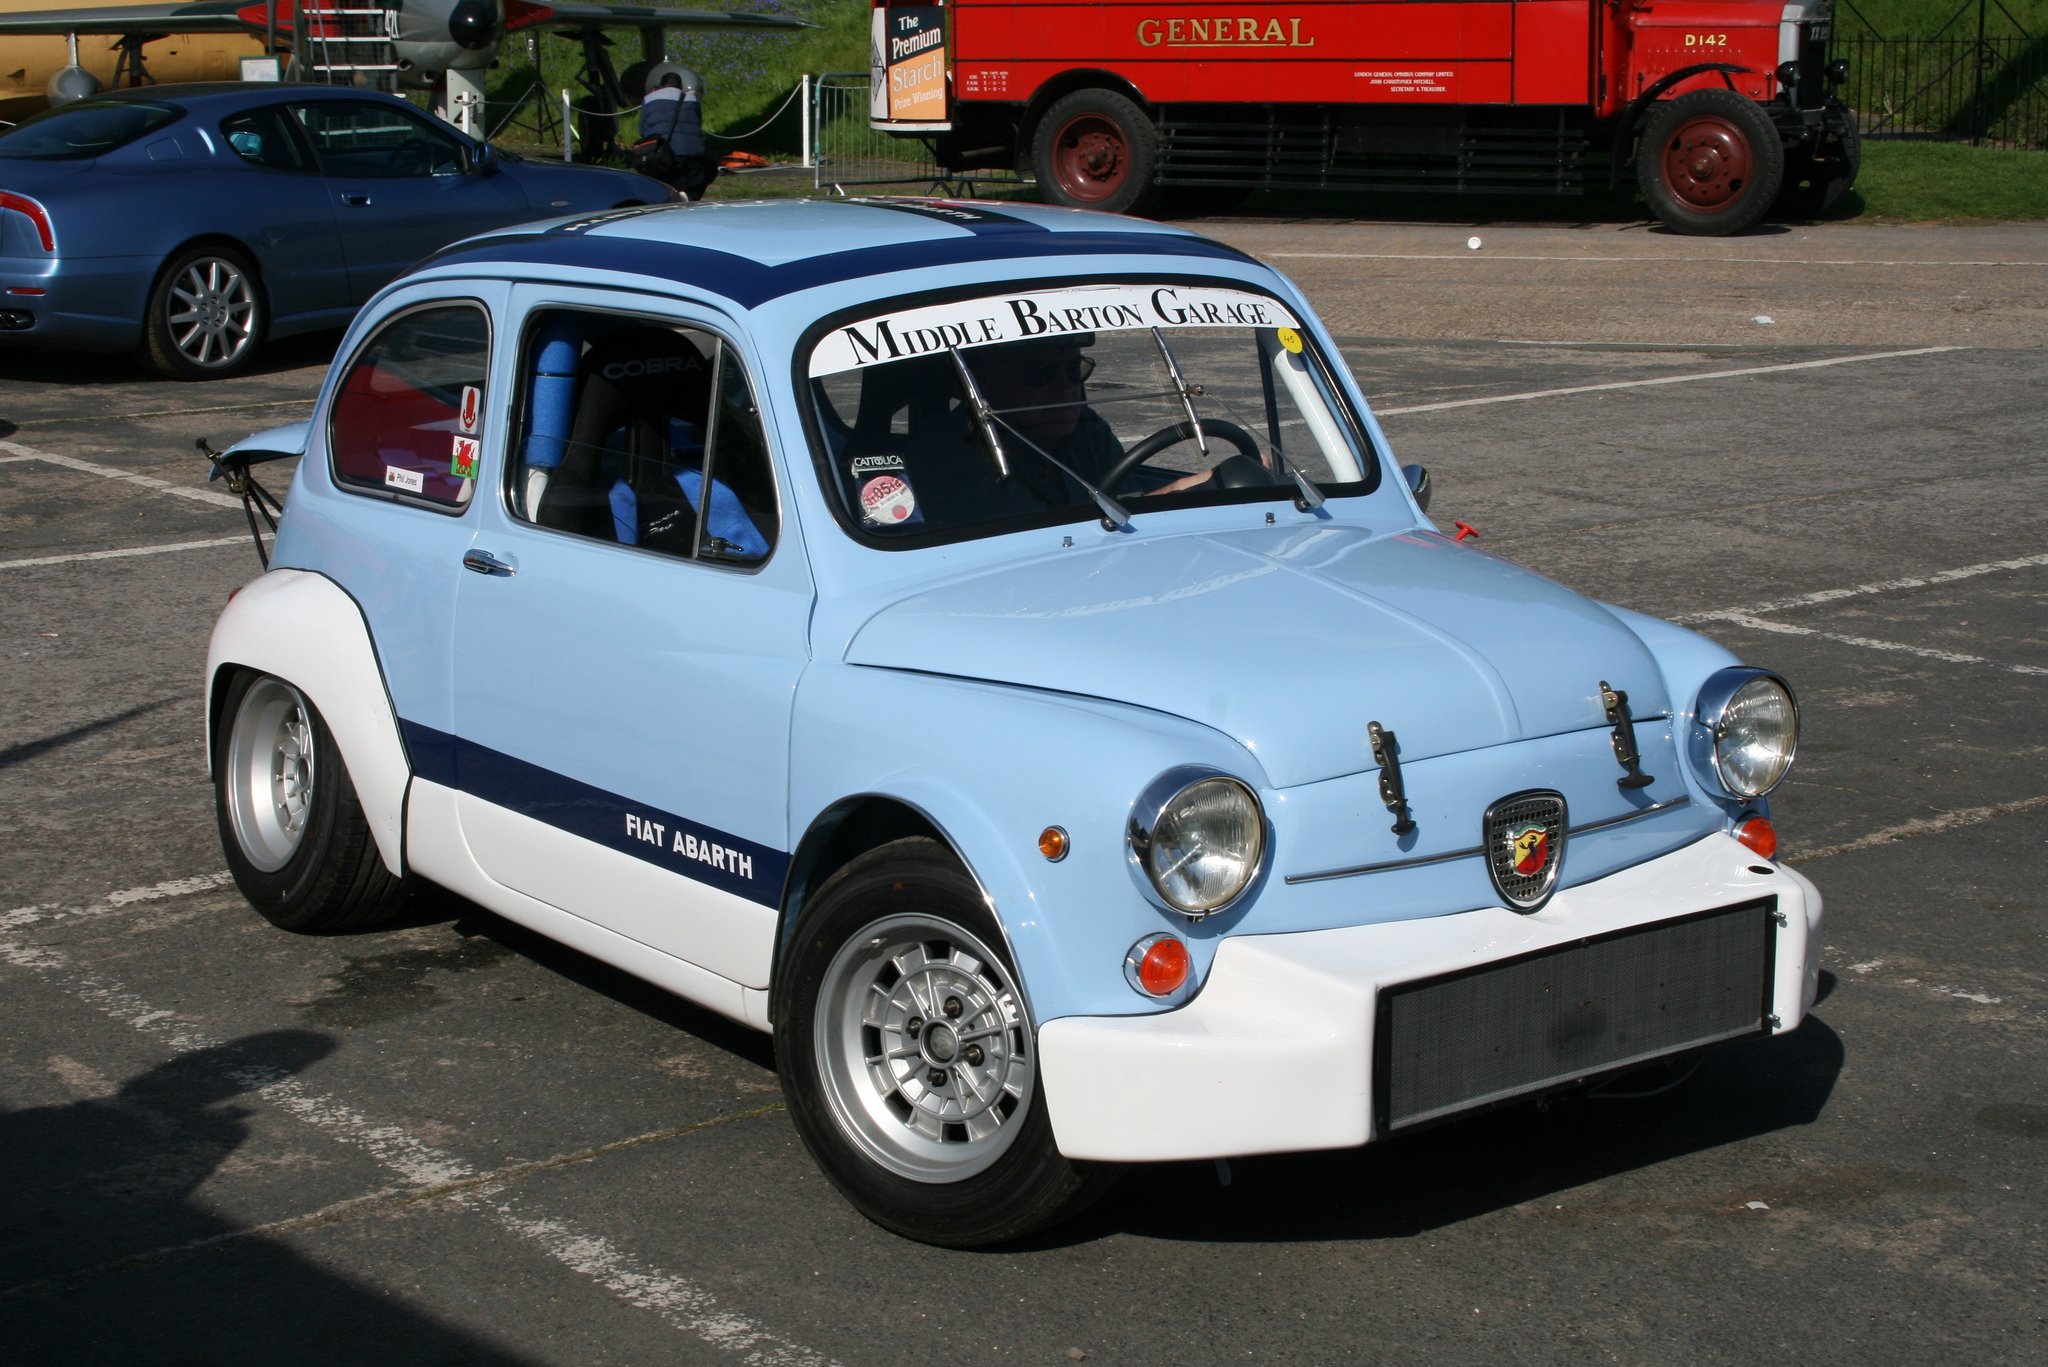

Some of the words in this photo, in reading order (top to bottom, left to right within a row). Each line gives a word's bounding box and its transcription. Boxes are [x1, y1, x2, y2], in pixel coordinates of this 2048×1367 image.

[898, 16, 919, 31] The
[1136, 17, 1315, 47] GENERAL
[892, 28, 941, 60] Premium
[893, 55, 941, 92] Starch
[894, 97, 911, 111] Prize
[912, 87, 943, 103] Winning
[840, 317, 1003, 366] MIDDLE
[1005, 298, 1146, 336] BARTON
[1151, 287, 1273, 326] GARAGE
[1283, 335, 1295, 344] 45
[602, 355, 705, 380] COBRA
[625, 812, 665, 848] FIAT
[672, 830, 753, 880] ABARTH
